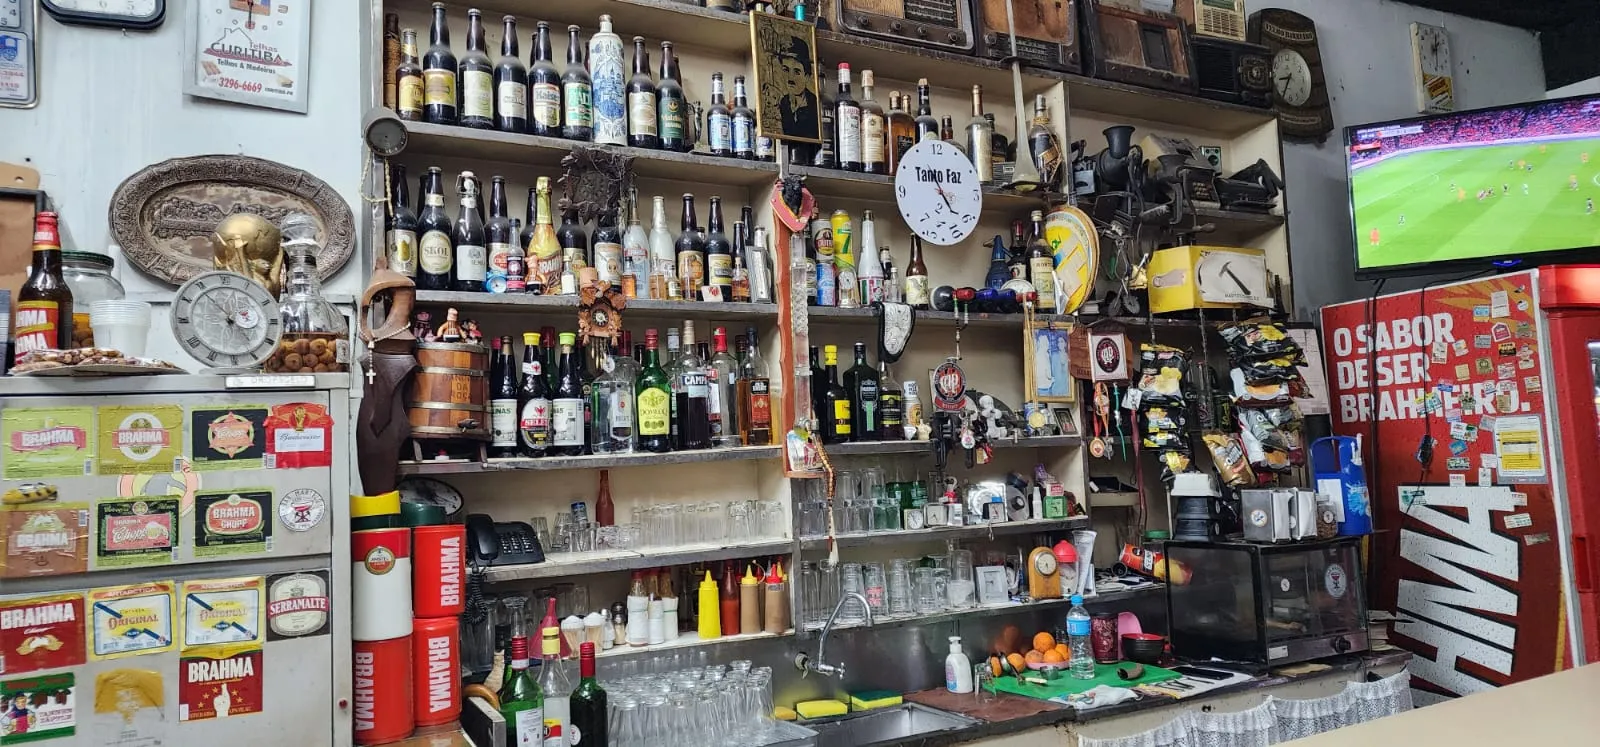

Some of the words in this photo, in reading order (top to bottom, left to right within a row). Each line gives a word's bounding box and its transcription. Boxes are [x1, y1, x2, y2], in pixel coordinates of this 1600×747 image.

[210, 42, 283, 63] CURITIBA
[249, 41, 278, 52] Telhas
[218, 77, 263, 93] 3296-6669
[931, 143, 943, 155] 12
[915, 166, 943, 183] Tanto
[946, 168, 962, 184] Faz
[898, 184, 906, 199] 9
[1333, 327, 1351, 357] O
[1337, 358, 1370, 390] DE
[1376, 351, 1432, 388] SER
[22, 430, 75, 446] BRAHMA
[118, 431, 163, 443] BRAHMA
[213, 506, 256, 519] BRAHMA
[220, 518, 247, 529] CHOPP
[440, 536, 460, 607] BRAHMA
[270, 597, 326, 616] SERRAMALTE
[0, 603, 76, 630] BRAHMA
[188, 656, 255, 683] BRAHMA
[428, 635, 452, 713] BRAHMA
[355, 651, 374, 731] BRAHMA
